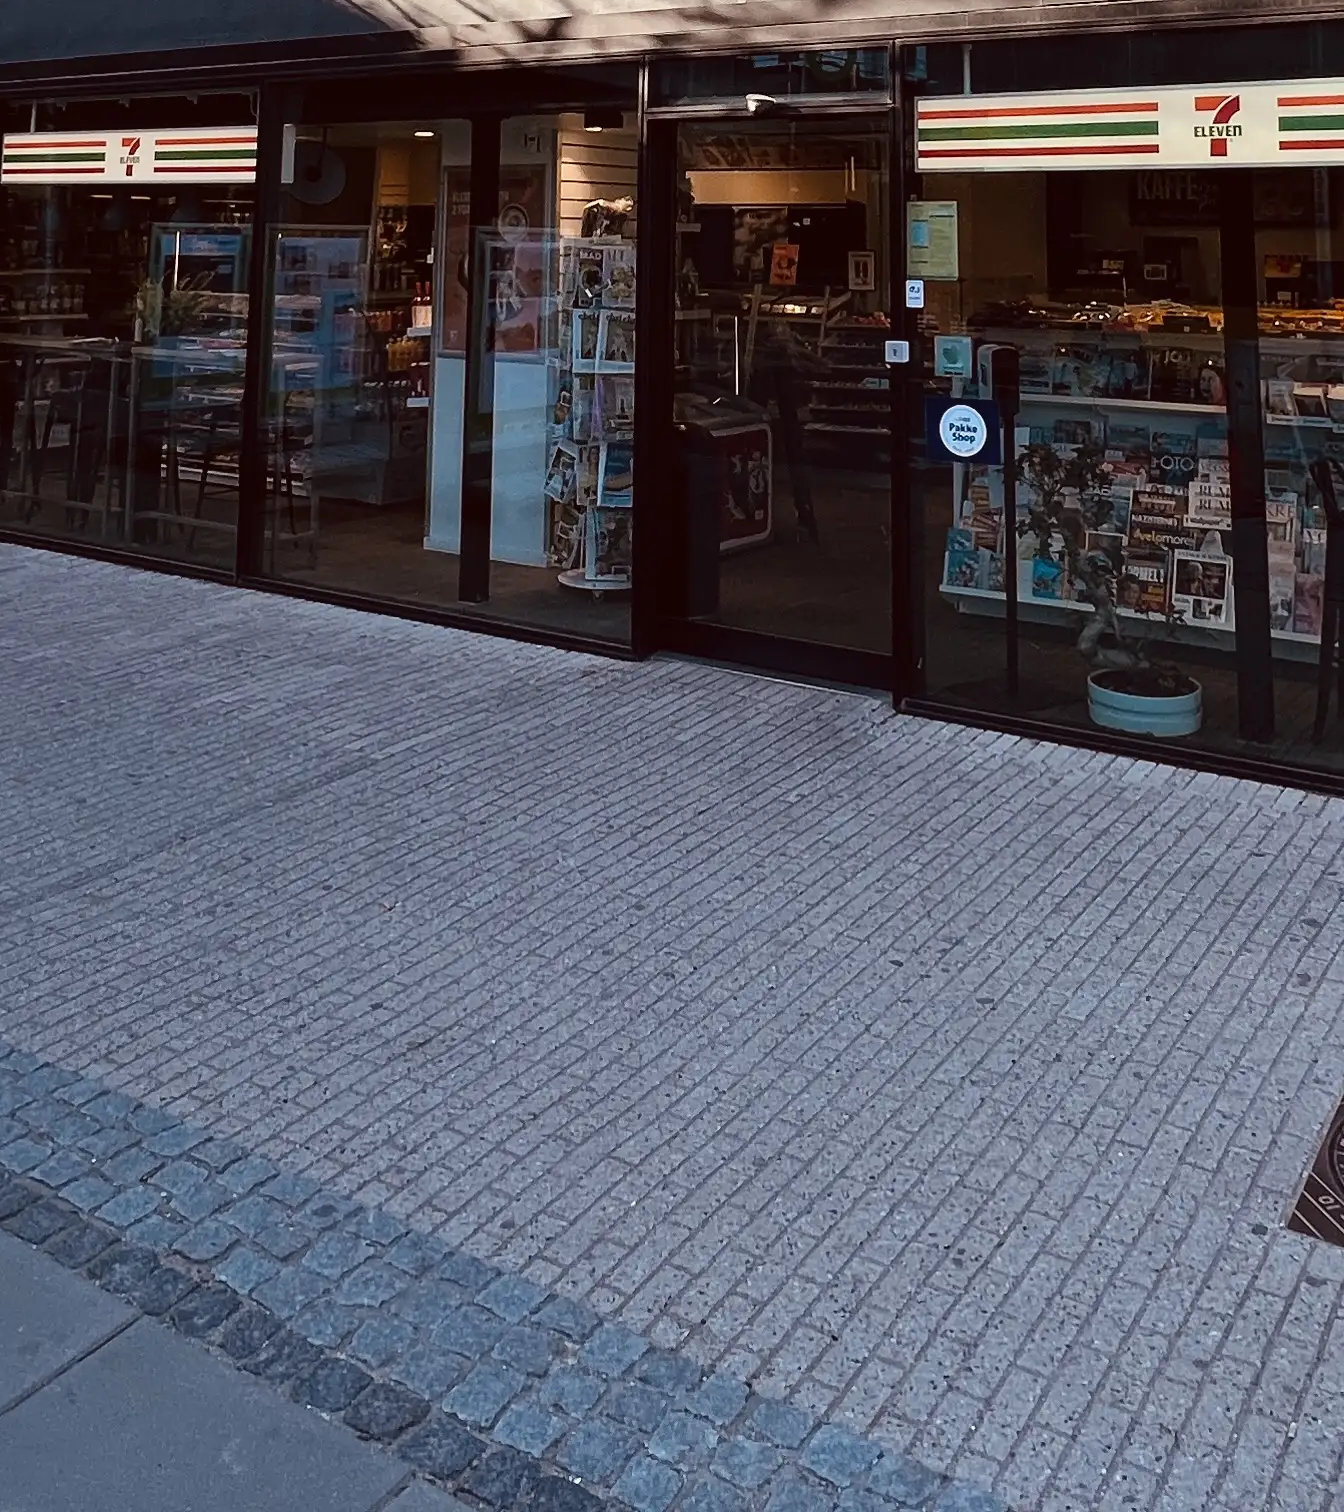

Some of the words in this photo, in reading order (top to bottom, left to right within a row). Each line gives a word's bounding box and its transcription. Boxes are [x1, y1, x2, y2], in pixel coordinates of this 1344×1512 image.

[1194, 95, 1241, 156] 7
[122, 137, 141, 176] 7
[949, 422, 978, 433] Pakke
[952, 432, 976, 444] Shop
